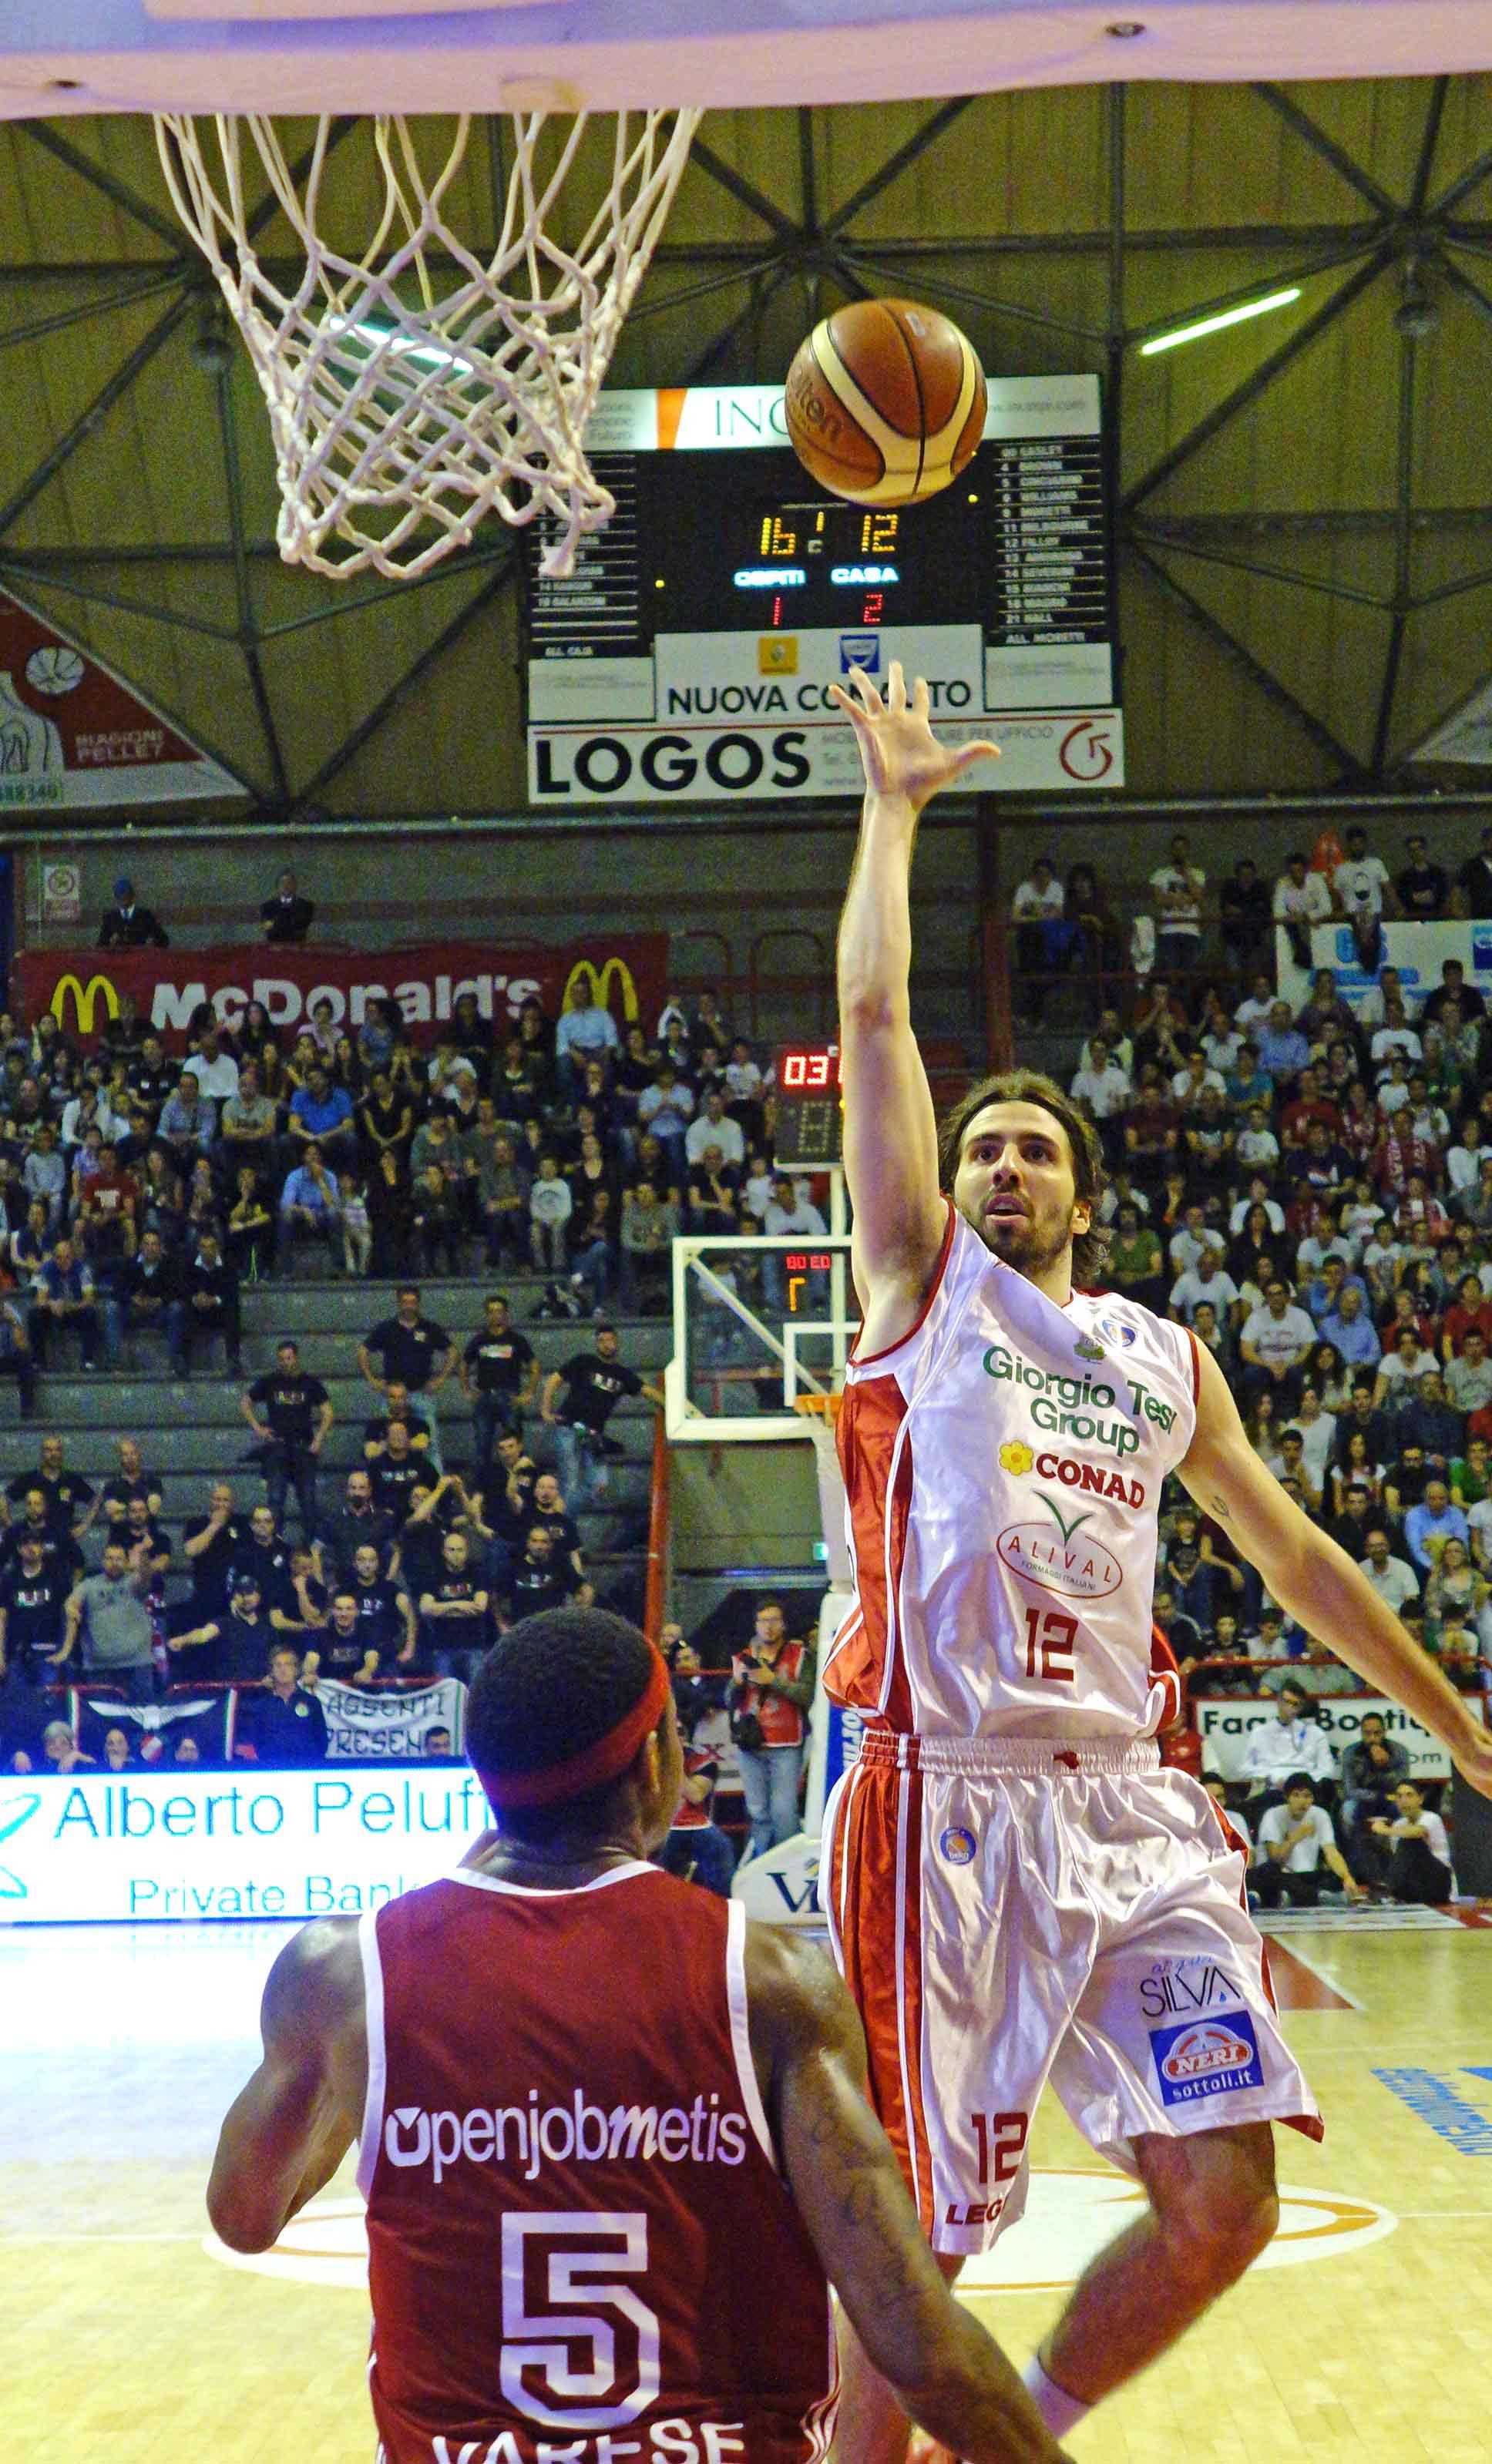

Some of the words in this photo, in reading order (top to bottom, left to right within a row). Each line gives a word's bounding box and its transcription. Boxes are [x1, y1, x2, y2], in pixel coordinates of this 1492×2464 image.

[862, 514, 899, 552] 12
[830, 567, 899, 586] CASA
[863, 593, 884, 623] 2
[668, 683, 788, 715] NUOVA
[536, 732, 810, 794] LOGOS
[151, 975, 542, 1030] McDonald's
[983, 1345, 1117, 1409] Giorgio
[1030, 1398, 1140, 1457] Group
[1036, 1453, 1146, 1509] CONAD
[1007, 1536, 1111, 1583] ALIVAL
[1026, 1608, 1078, 1682] 12
[54, 1783, 285, 1839] Alberto
[129, 1877, 286, 1914] Private
[1139, 1965, 1242, 2018] SILVA
[1174, 2043, 1241, 2076] NERI
[971, 2111, 1029, 2184] 12
[499, 2211, 661, 2429] 5
